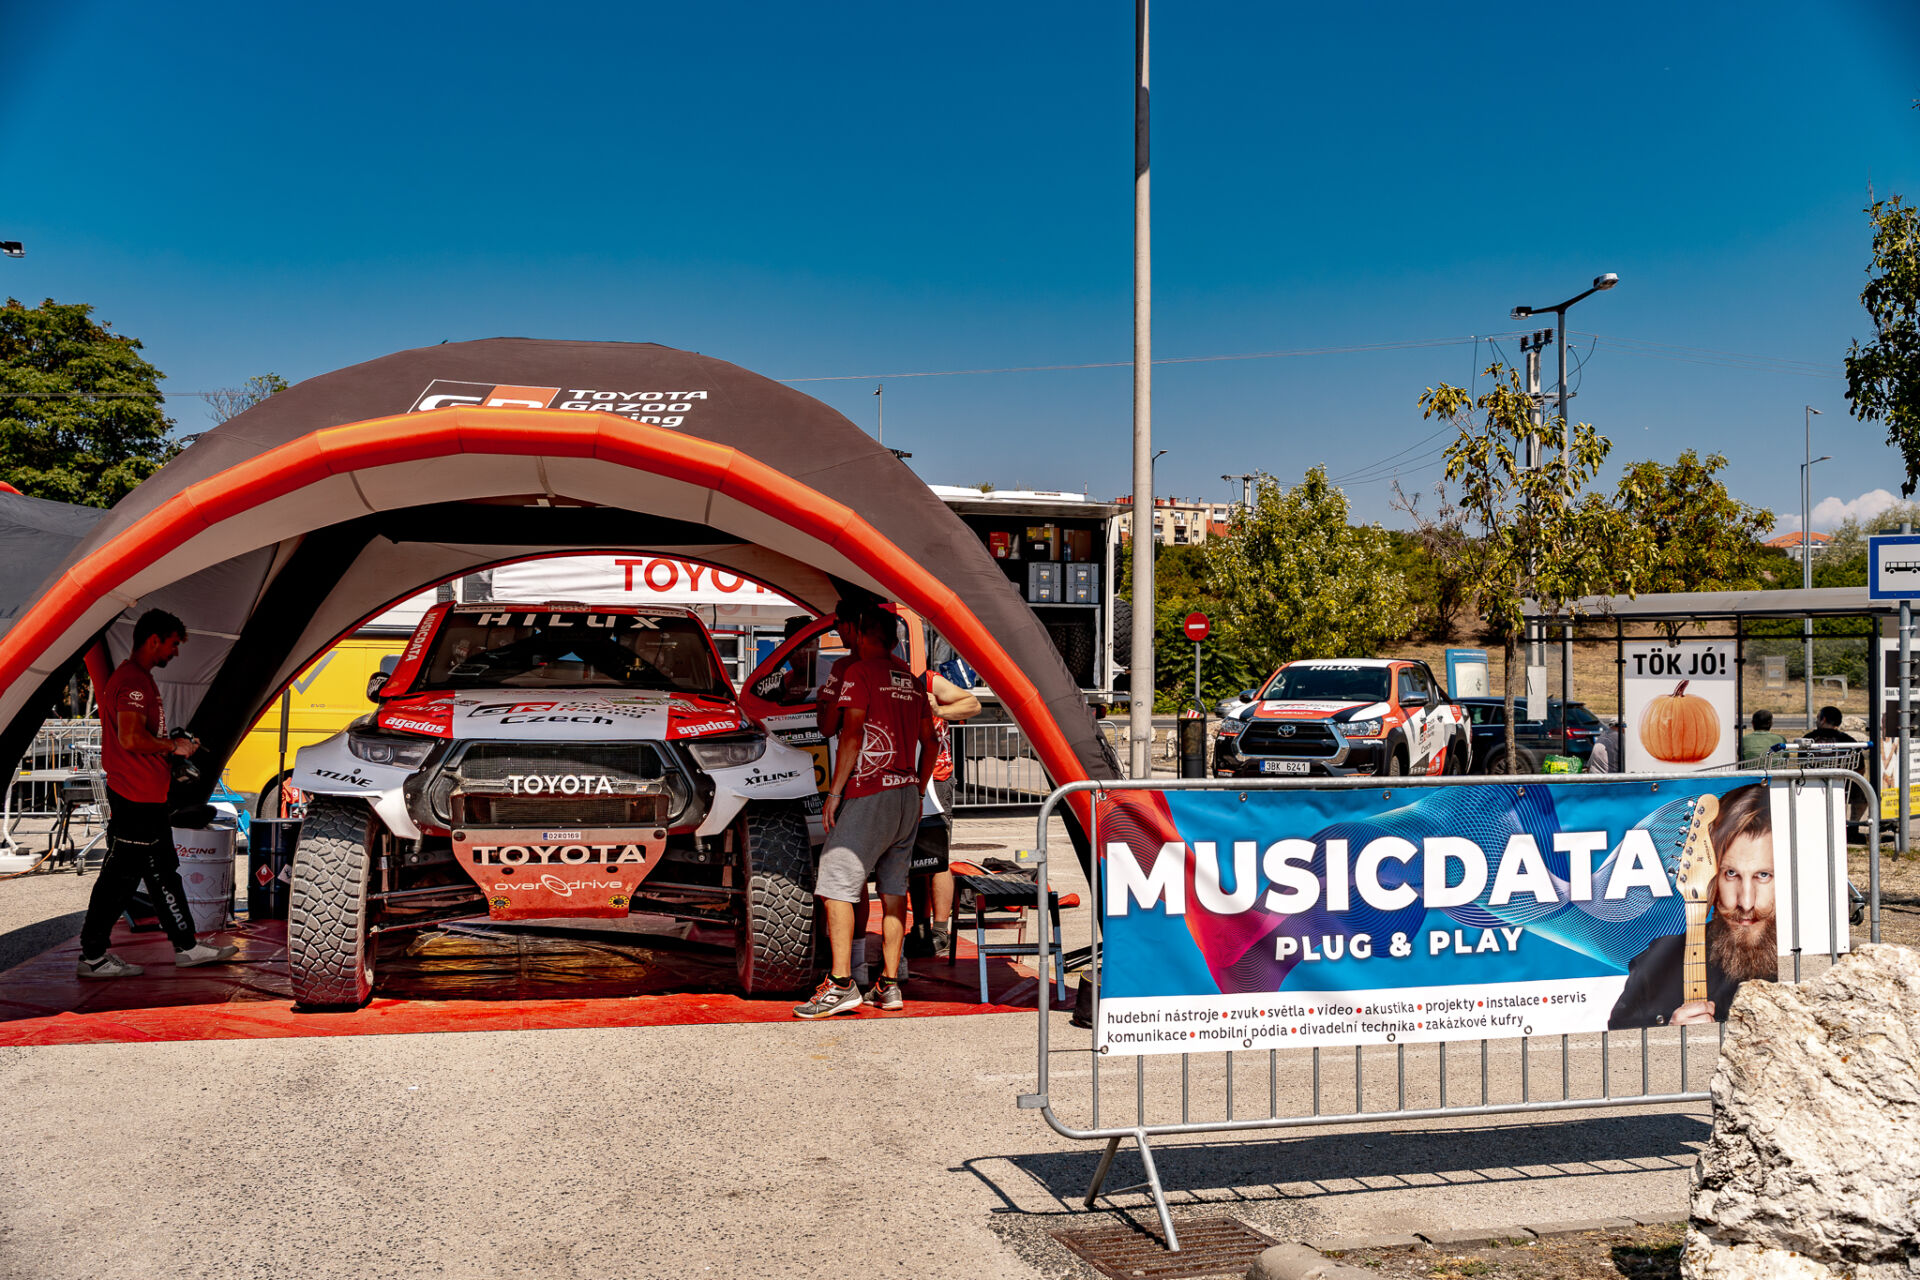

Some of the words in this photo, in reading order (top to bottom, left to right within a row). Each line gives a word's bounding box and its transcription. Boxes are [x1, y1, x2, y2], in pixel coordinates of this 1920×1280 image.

[568, 389, 708, 400] TOYOTA
[559, 401, 692, 412] GAZOO
[615, 558, 775, 593] TOYO
[477, 613, 662, 629] HILUX
[404, 612, 438, 662] MUSICDATA
[1633, 648, 1682, 675] TÖK
[1688, 647, 1726, 675] JÓ!
[385, 716, 447, 733] agados
[500, 715, 613, 725] Czech
[676, 720, 736, 736] agados
[1266, 762, 1281, 770] 3BK
[1287, 763, 1306, 772] 6241
[310, 768, 373, 788] XTLINE
[507, 775, 614, 795] TOYOTA
[744, 770, 801, 786] XTLINE
[473, 844, 645, 866] TOYOTA
[914, 857, 939, 867] KAFKA
[1106, 829, 1673, 917] MUSICDATA
[1275, 933, 1372, 961] PLUG
[1389, 932, 1412, 957] &
[1429, 927, 1524, 956] PLAY
[1107, 1010, 1160, 1024] hudební
[1165, 1009, 1219, 1024] nástroje
[1230, 1007, 1258, 1020] zvuk
[1267, 1005, 1305, 1018] světla
[1317, 1003, 1353, 1016] video
[1365, 1002, 1415, 1015] akustika
[1425, 998, 1475, 1014] projekty
[1486, 996, 1540, 1009] instalace
[1550, 991, 1587, 1005] servis
[1107, 1029, 1187, 1043] komunikace
[1199, 1025, 1247, 1040] mobilní
[1251, 1024, 1287, 1039] pódia
[1300, 1021, 1357, 1035] divadelní
[1362, 1020, 1415, 1033] technika
[1425, 1014, 1487, 1031] zakázkové
[1491, 1013, 1524, 1028] kufry
